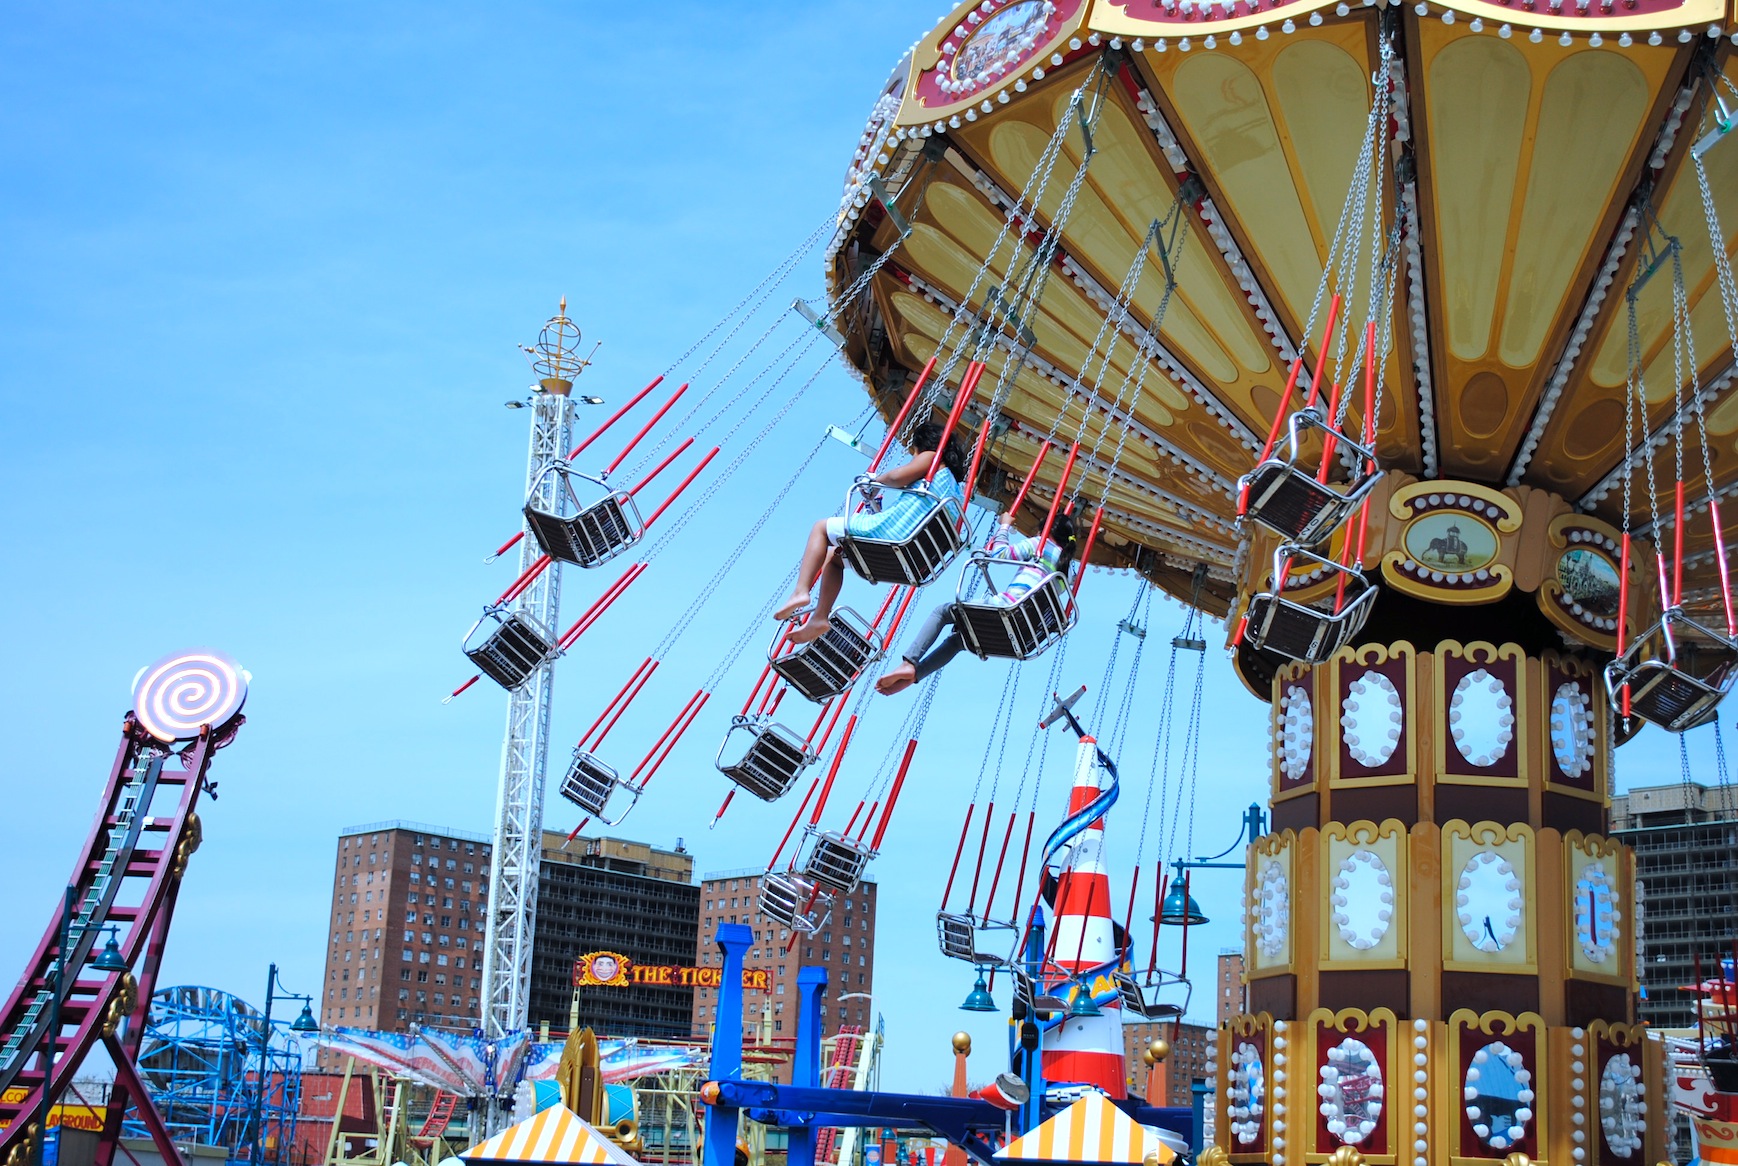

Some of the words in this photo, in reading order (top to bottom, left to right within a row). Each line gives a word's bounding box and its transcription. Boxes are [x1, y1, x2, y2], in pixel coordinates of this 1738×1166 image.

[1301, 518, 1319, 536] 20
[632, 965, 673, 984] THE
[679, 967, 768, 989] TICKER
